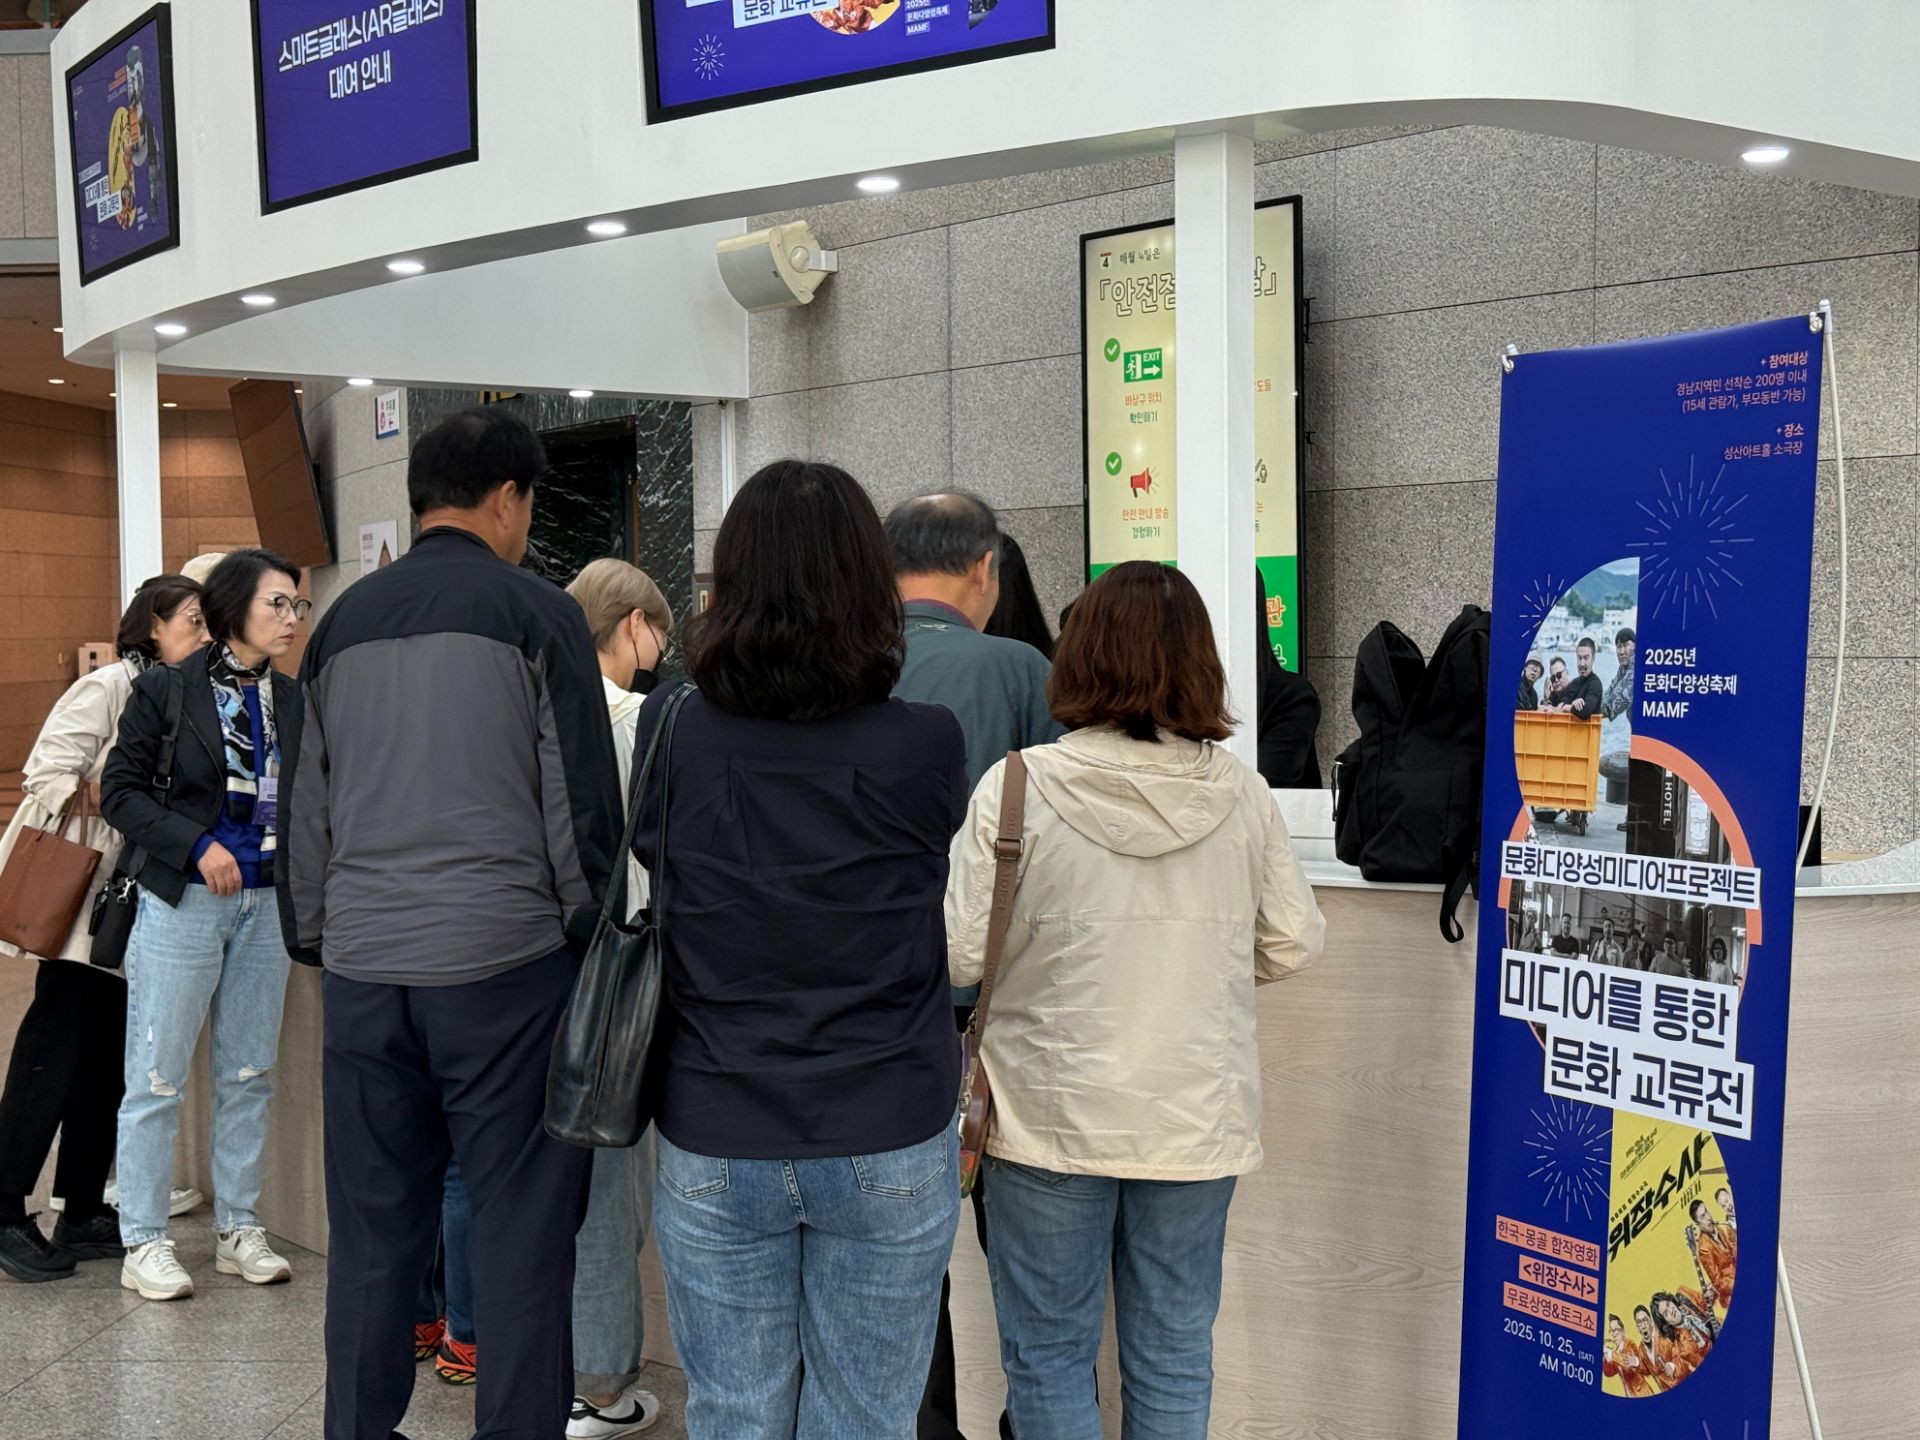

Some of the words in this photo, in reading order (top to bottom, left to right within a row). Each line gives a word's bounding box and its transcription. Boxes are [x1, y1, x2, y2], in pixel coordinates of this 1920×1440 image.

[279, 0, 444, 72] 스마트글래스(AR글래스)
[907, 23, 929, 33] MAMF
[329, 60, 358, 99] 대여
[361, 50, 391, 91] 안내
[1143, 351, 1160, 362] EXIT
[1769, 351, 1808, 369] 참여대상
[1676, 378, 1722, 397] 경남지역민
[1724, 375, 1753, 391] 선착순
[1755, 371, 1785, 387] 200명
[1788, 369, 1808, 383] 이내
[1148, 391, 1162, 404] 위치
[1682, 398, 1706, 414] (15세
[1708, 394, 1739, 410] 관람가,
[1741, 389, 1780, 406] 부모동반
[1782, 387, 1806, 403] 가능)
[1129, 411, 1158, 424] 확인하기
[1784, 423, 1804, 438] 장소
[1724, 443, 1771, 460] 성산아트홀
[1774, 440, 1803, 456] 소극장
[1155, 506, 1169, 519] 방송
[1645, 647, 1696, 667] 2025년
[1643, 673, 1738, 695] 문화다양성축제
[1642, 700, 1690, 718] MAMF
[1663, 781, 1673, 825] HOTEL
[1504, 845, 1756, 903] 문화다양성미디어프로젝트
[1504, 959, 1642, 1033] 미디어를
[1653, 983, 1730, 1049] 통한
[1551, 1036, 1622, 1100] 문화
[1630, 1052, 1745, 1129] 교류전
[1498, 1219, 1548, 1250] 한국-몽골
[1551, 1234, 1597, 1267] 합작영화
[1523, 1261, 1596, 1298] <위장수사>
[1507, 1287, 1595, 1332] 무료상영&토크쇼
[1503, 1317, 1536, 1342] 2025.
[1538, 1329, 1554, 1349] 10.
[1557, 1336, 1576, 1357] 25.
[1578, 1350, 1595, 1364] (SAT)
[1539, 1353, 1559, 1373] AM
[1562, 1361, 1594, 1386] 10:00
